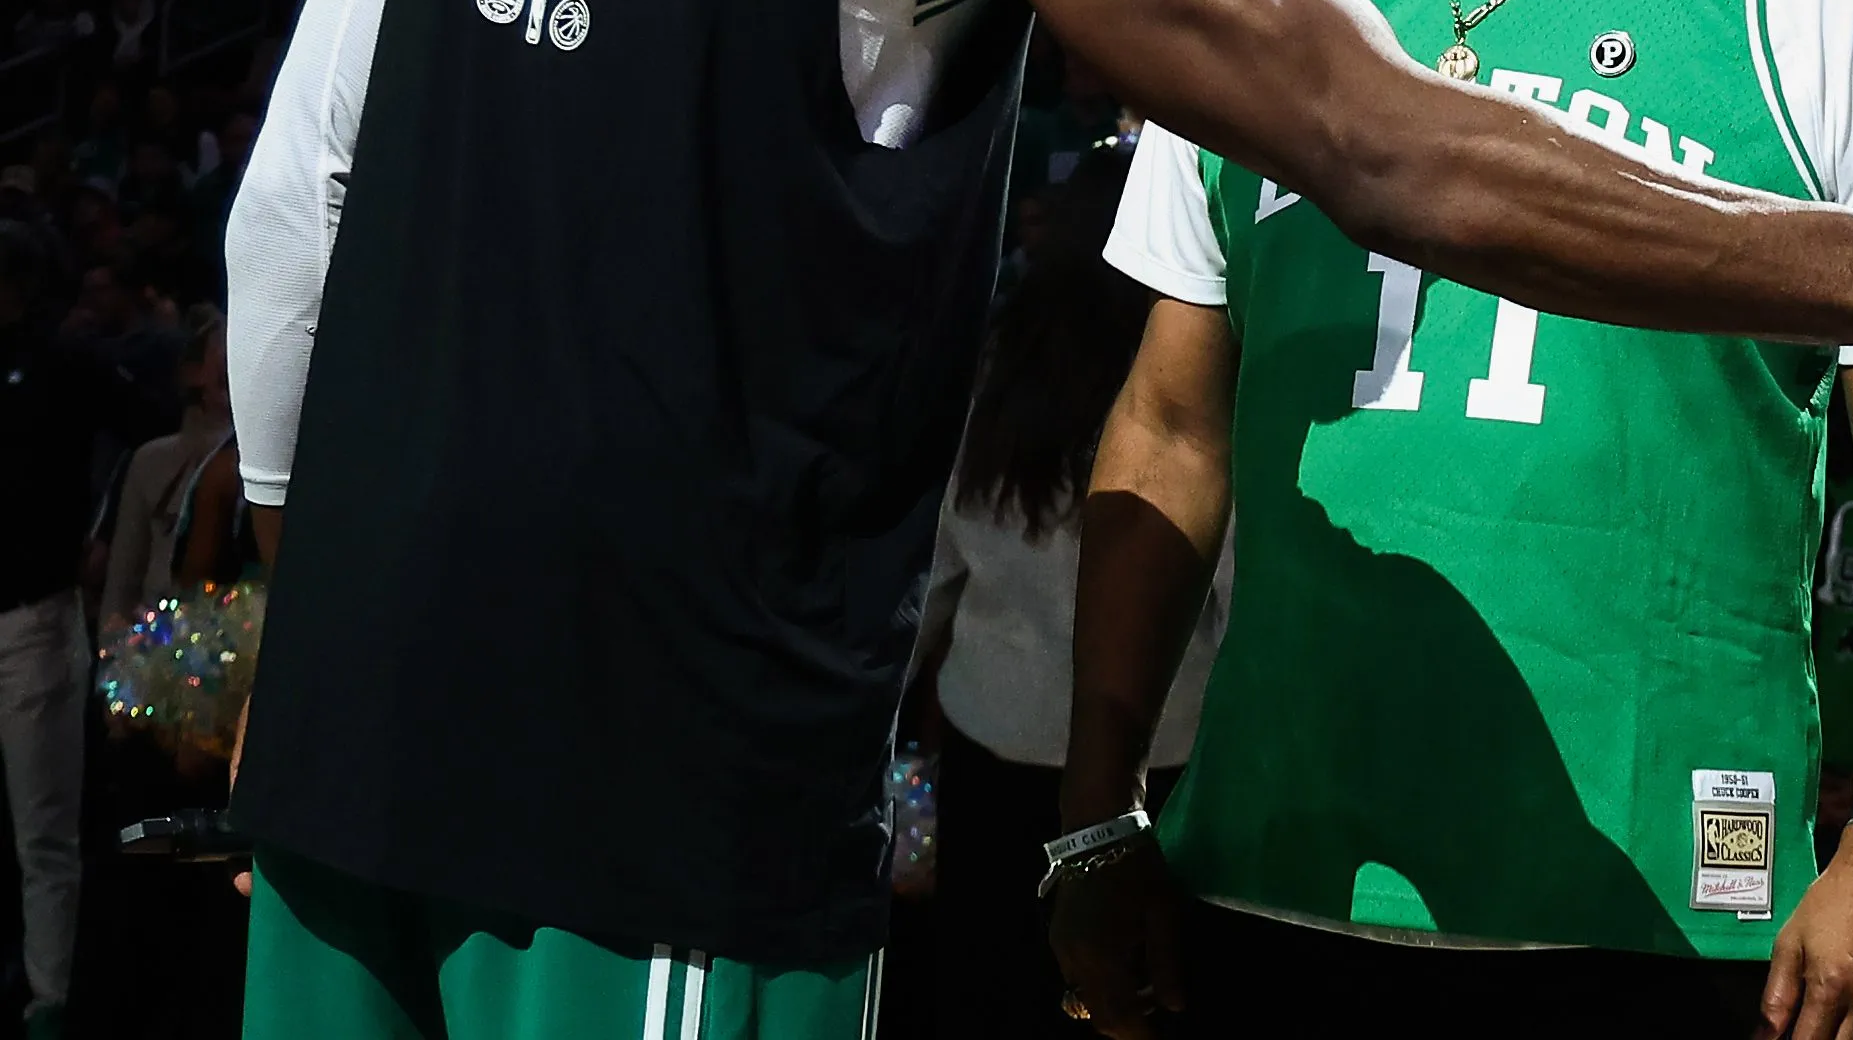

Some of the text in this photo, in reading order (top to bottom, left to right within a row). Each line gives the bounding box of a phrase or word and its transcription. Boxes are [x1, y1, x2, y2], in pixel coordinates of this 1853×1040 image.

[1352, 251, 1546, 425] 11
[1721, 818, 1763, 840] HARDWOOD
[1721, 843, 1762, 861] CLASSICS
